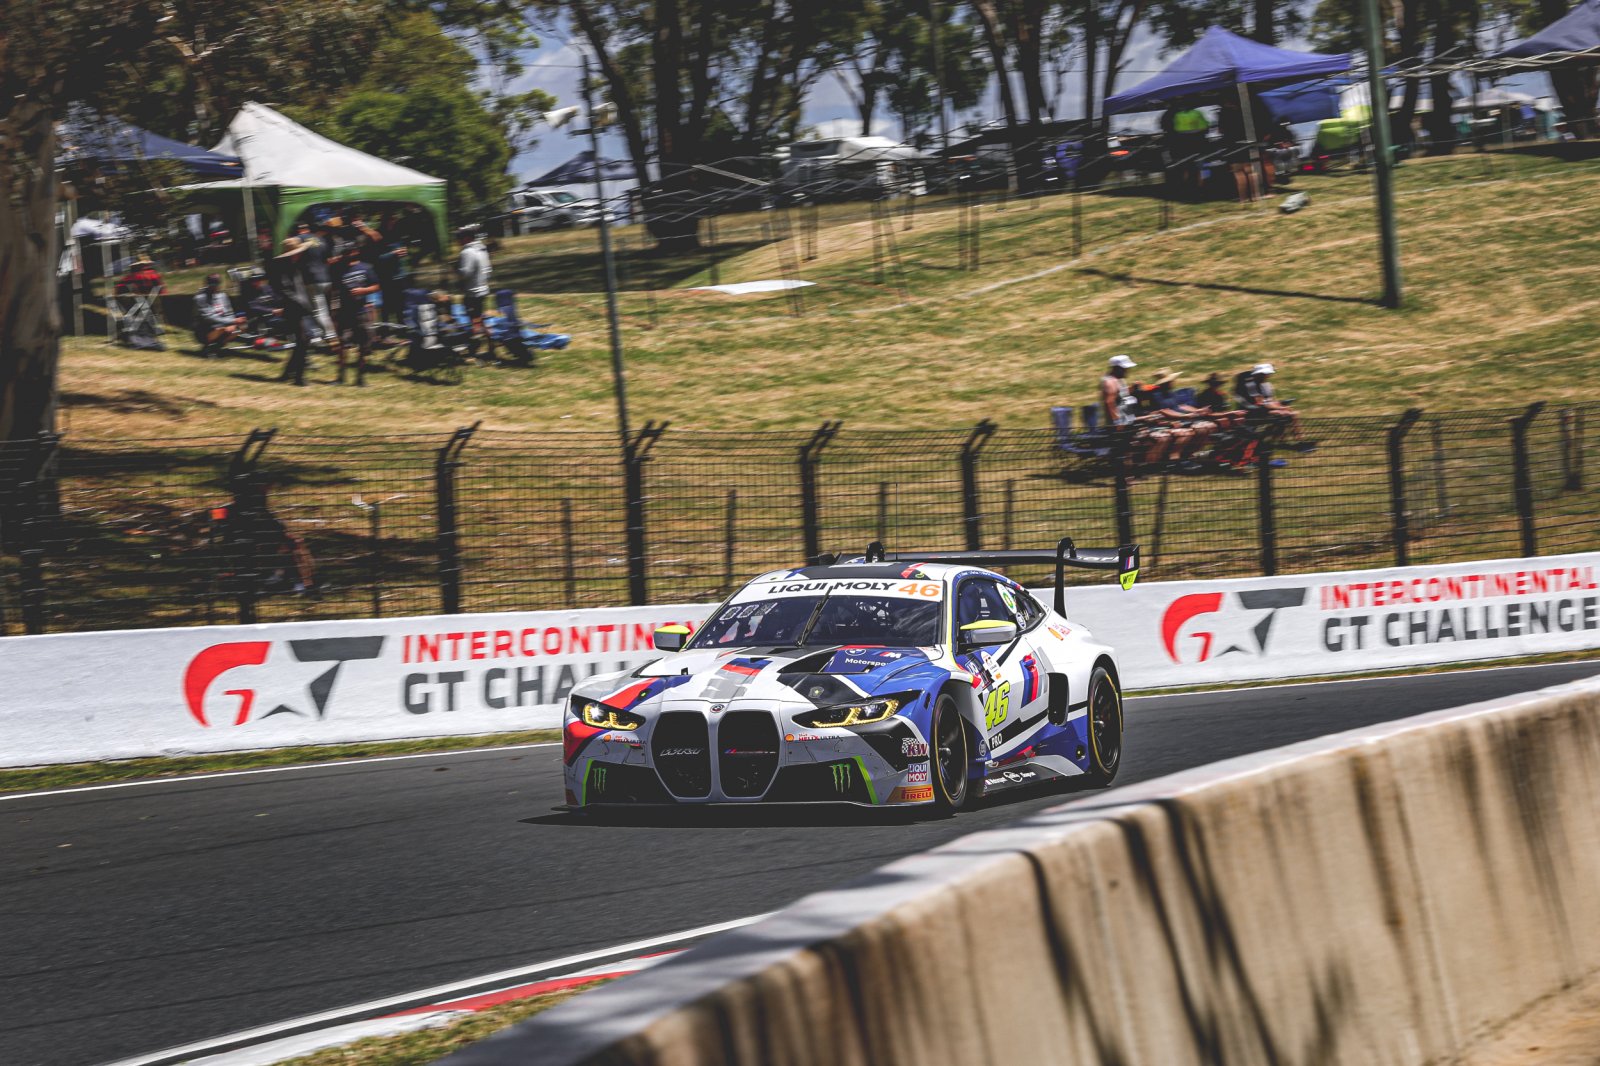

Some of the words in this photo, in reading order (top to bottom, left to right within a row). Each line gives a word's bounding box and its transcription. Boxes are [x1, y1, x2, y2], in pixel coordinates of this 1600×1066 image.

[767, 582, 829, 594] LIQUI
[832, 581, 897, 591] MOLY
[897, 582, 941, 597] 46
[1320, 566, 1598, 610] INTERCONTINENTAL
[1324, 614, 1369, 652] GT
[1384, 596, 1600, 648] CHALLENGE
[401, 619, 709, 663] INTERCONTIN
[403, 670, 465, 715] GT
[983, 680, 1010, 732] 46
[991, 732, 1003, 749] PRO
[906, 743, 929, 757] KW
[908, 763, 928, 773] LIQUI
[908, 772, 928, 782] MOLY
[901, 786, 933, 800] PIRELLI
